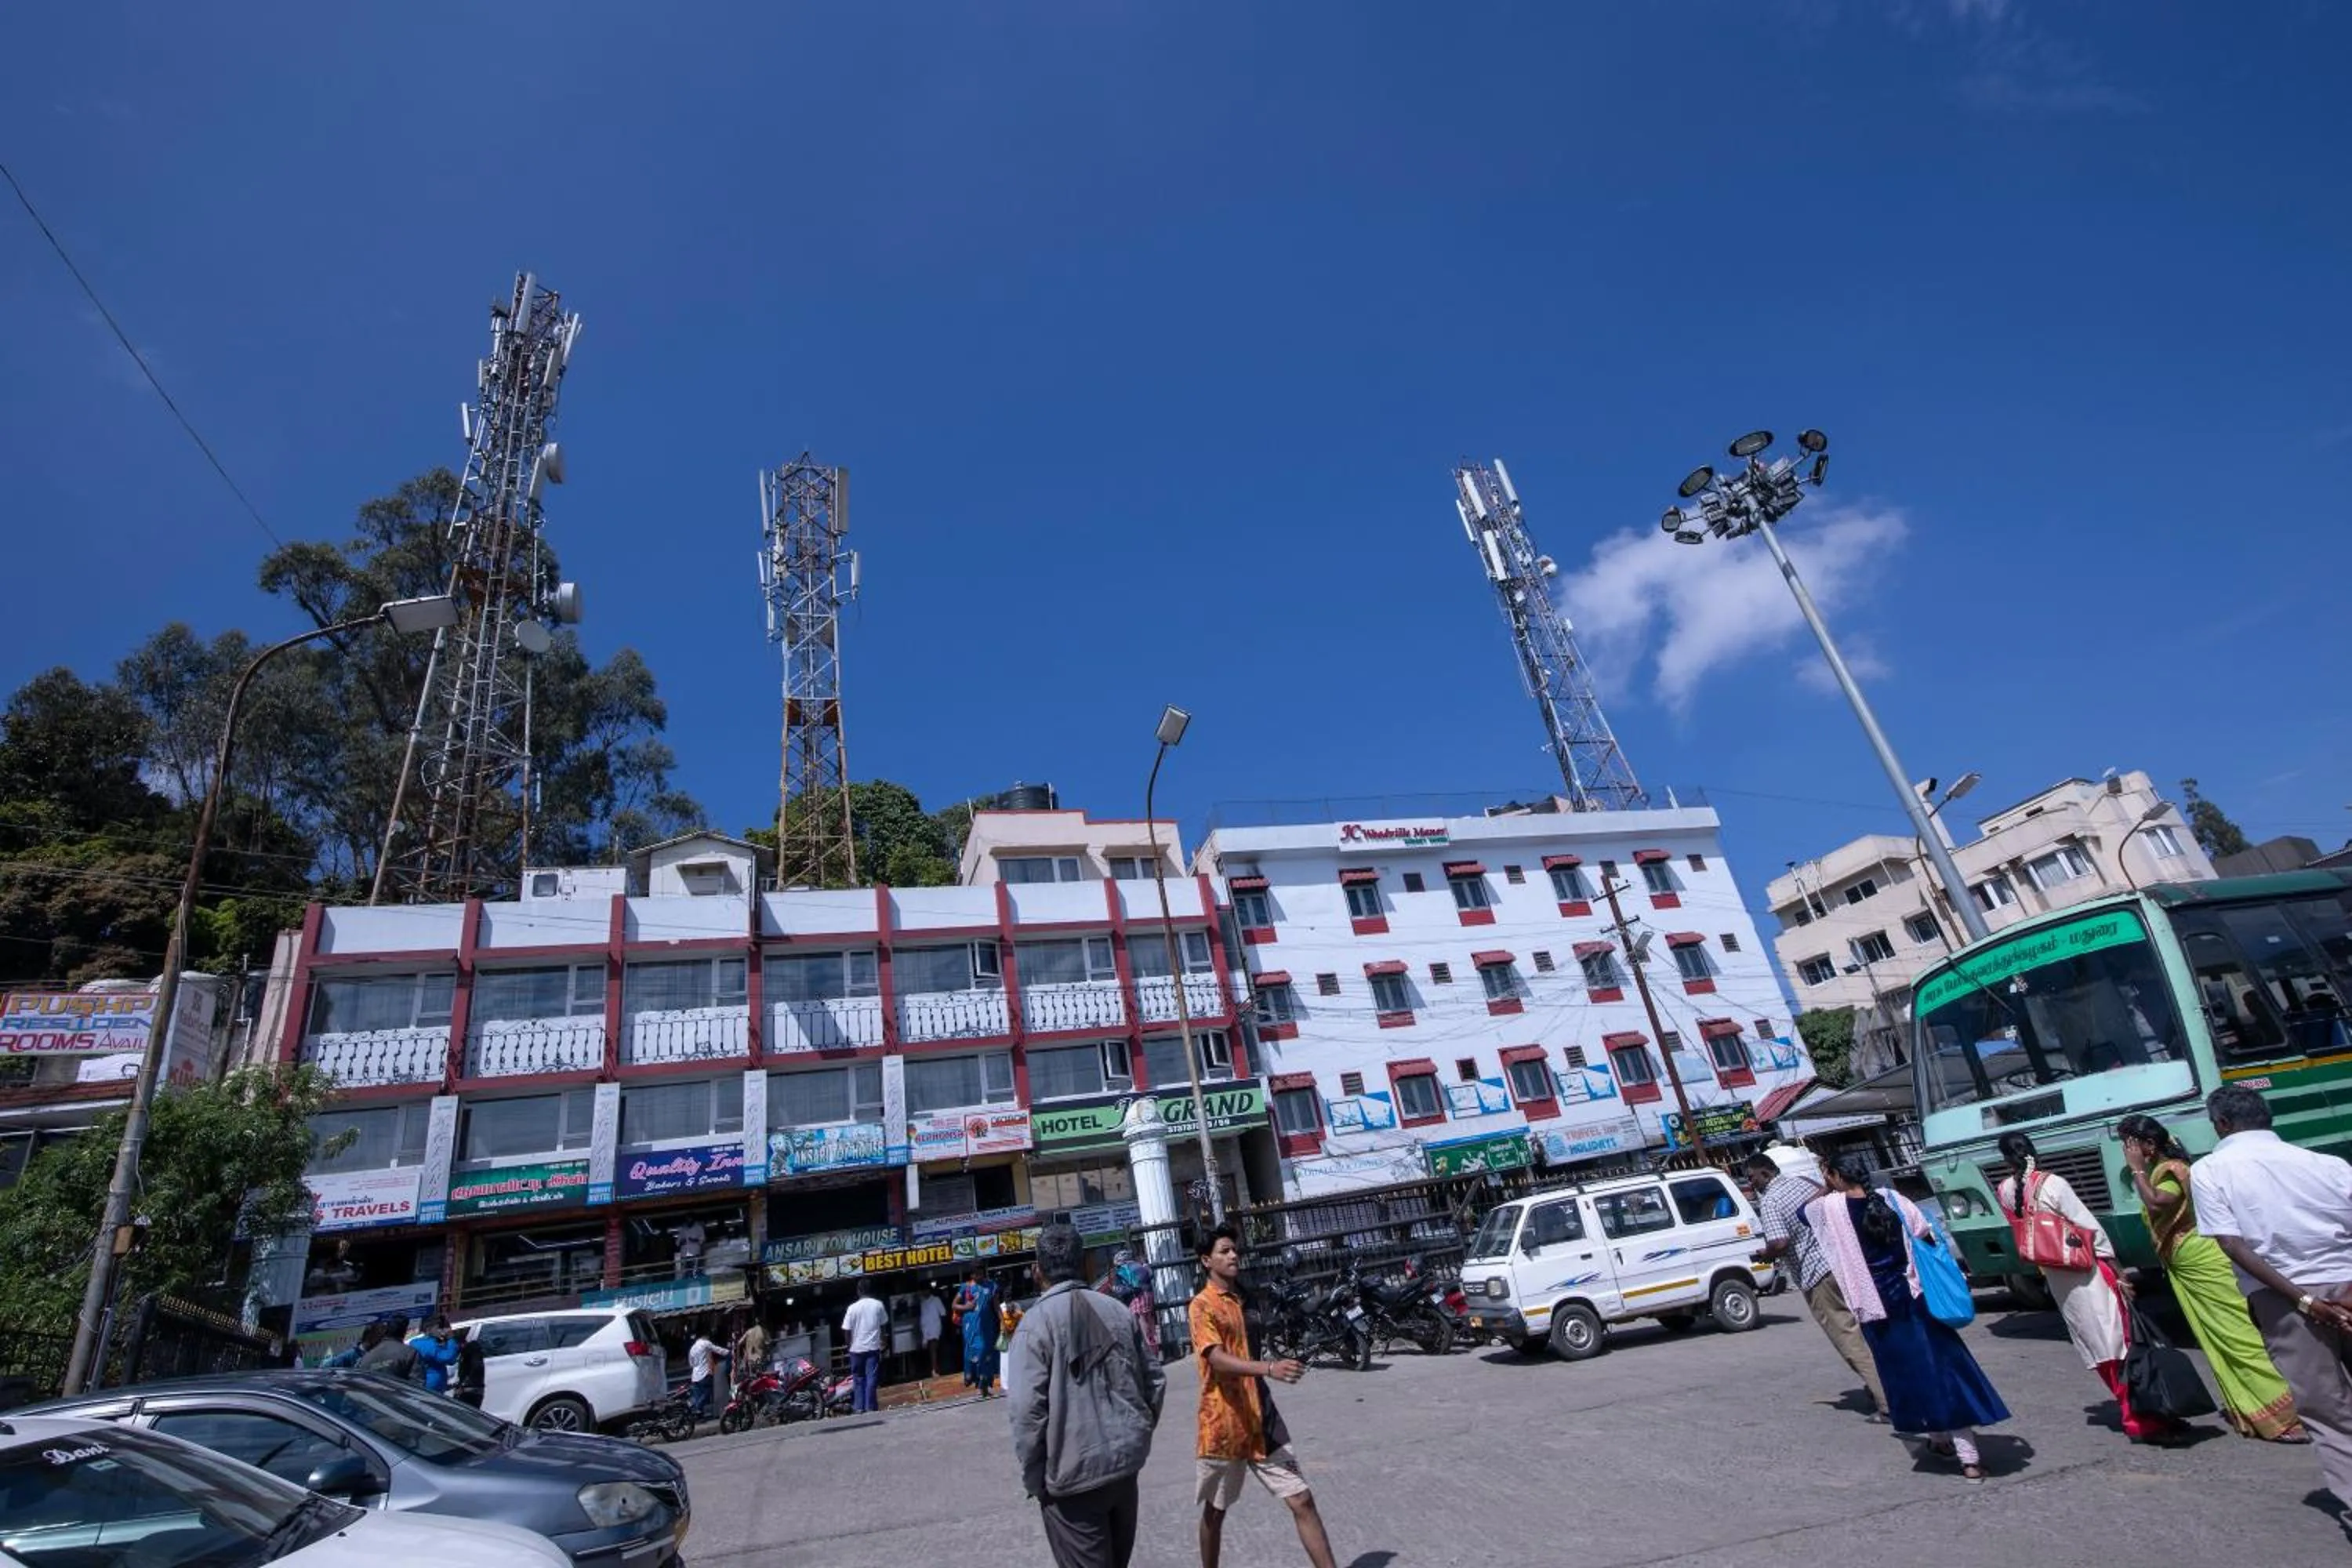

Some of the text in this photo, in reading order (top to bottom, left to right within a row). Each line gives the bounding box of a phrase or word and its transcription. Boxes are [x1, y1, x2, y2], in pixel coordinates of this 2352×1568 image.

[2069, 922, 2118, 946] மதுரை
[6, 995, 155, 1018] PUSHP
[1, 1017, 153, 1031] RESIDEN
[0, 1033, 97, 1053] ROOMS
[1041, 1114, 1102, 1134] HOTEL
[1163, 1092, 1254, 1124] GRAND
[1569, 1138, 1617, 1156] HOLIDAYS
[630, 1155, 701, 1180] Quality
[332, 1200, 411, 1219] TRAVELS
[765, 1240, 818, 1261] ANSARI
[822, 1234, 848, 1251] TOY
[852, 1227, 898, 1247] HOUSE
[865, 1246, 953, 1271] BEST HOTEL
